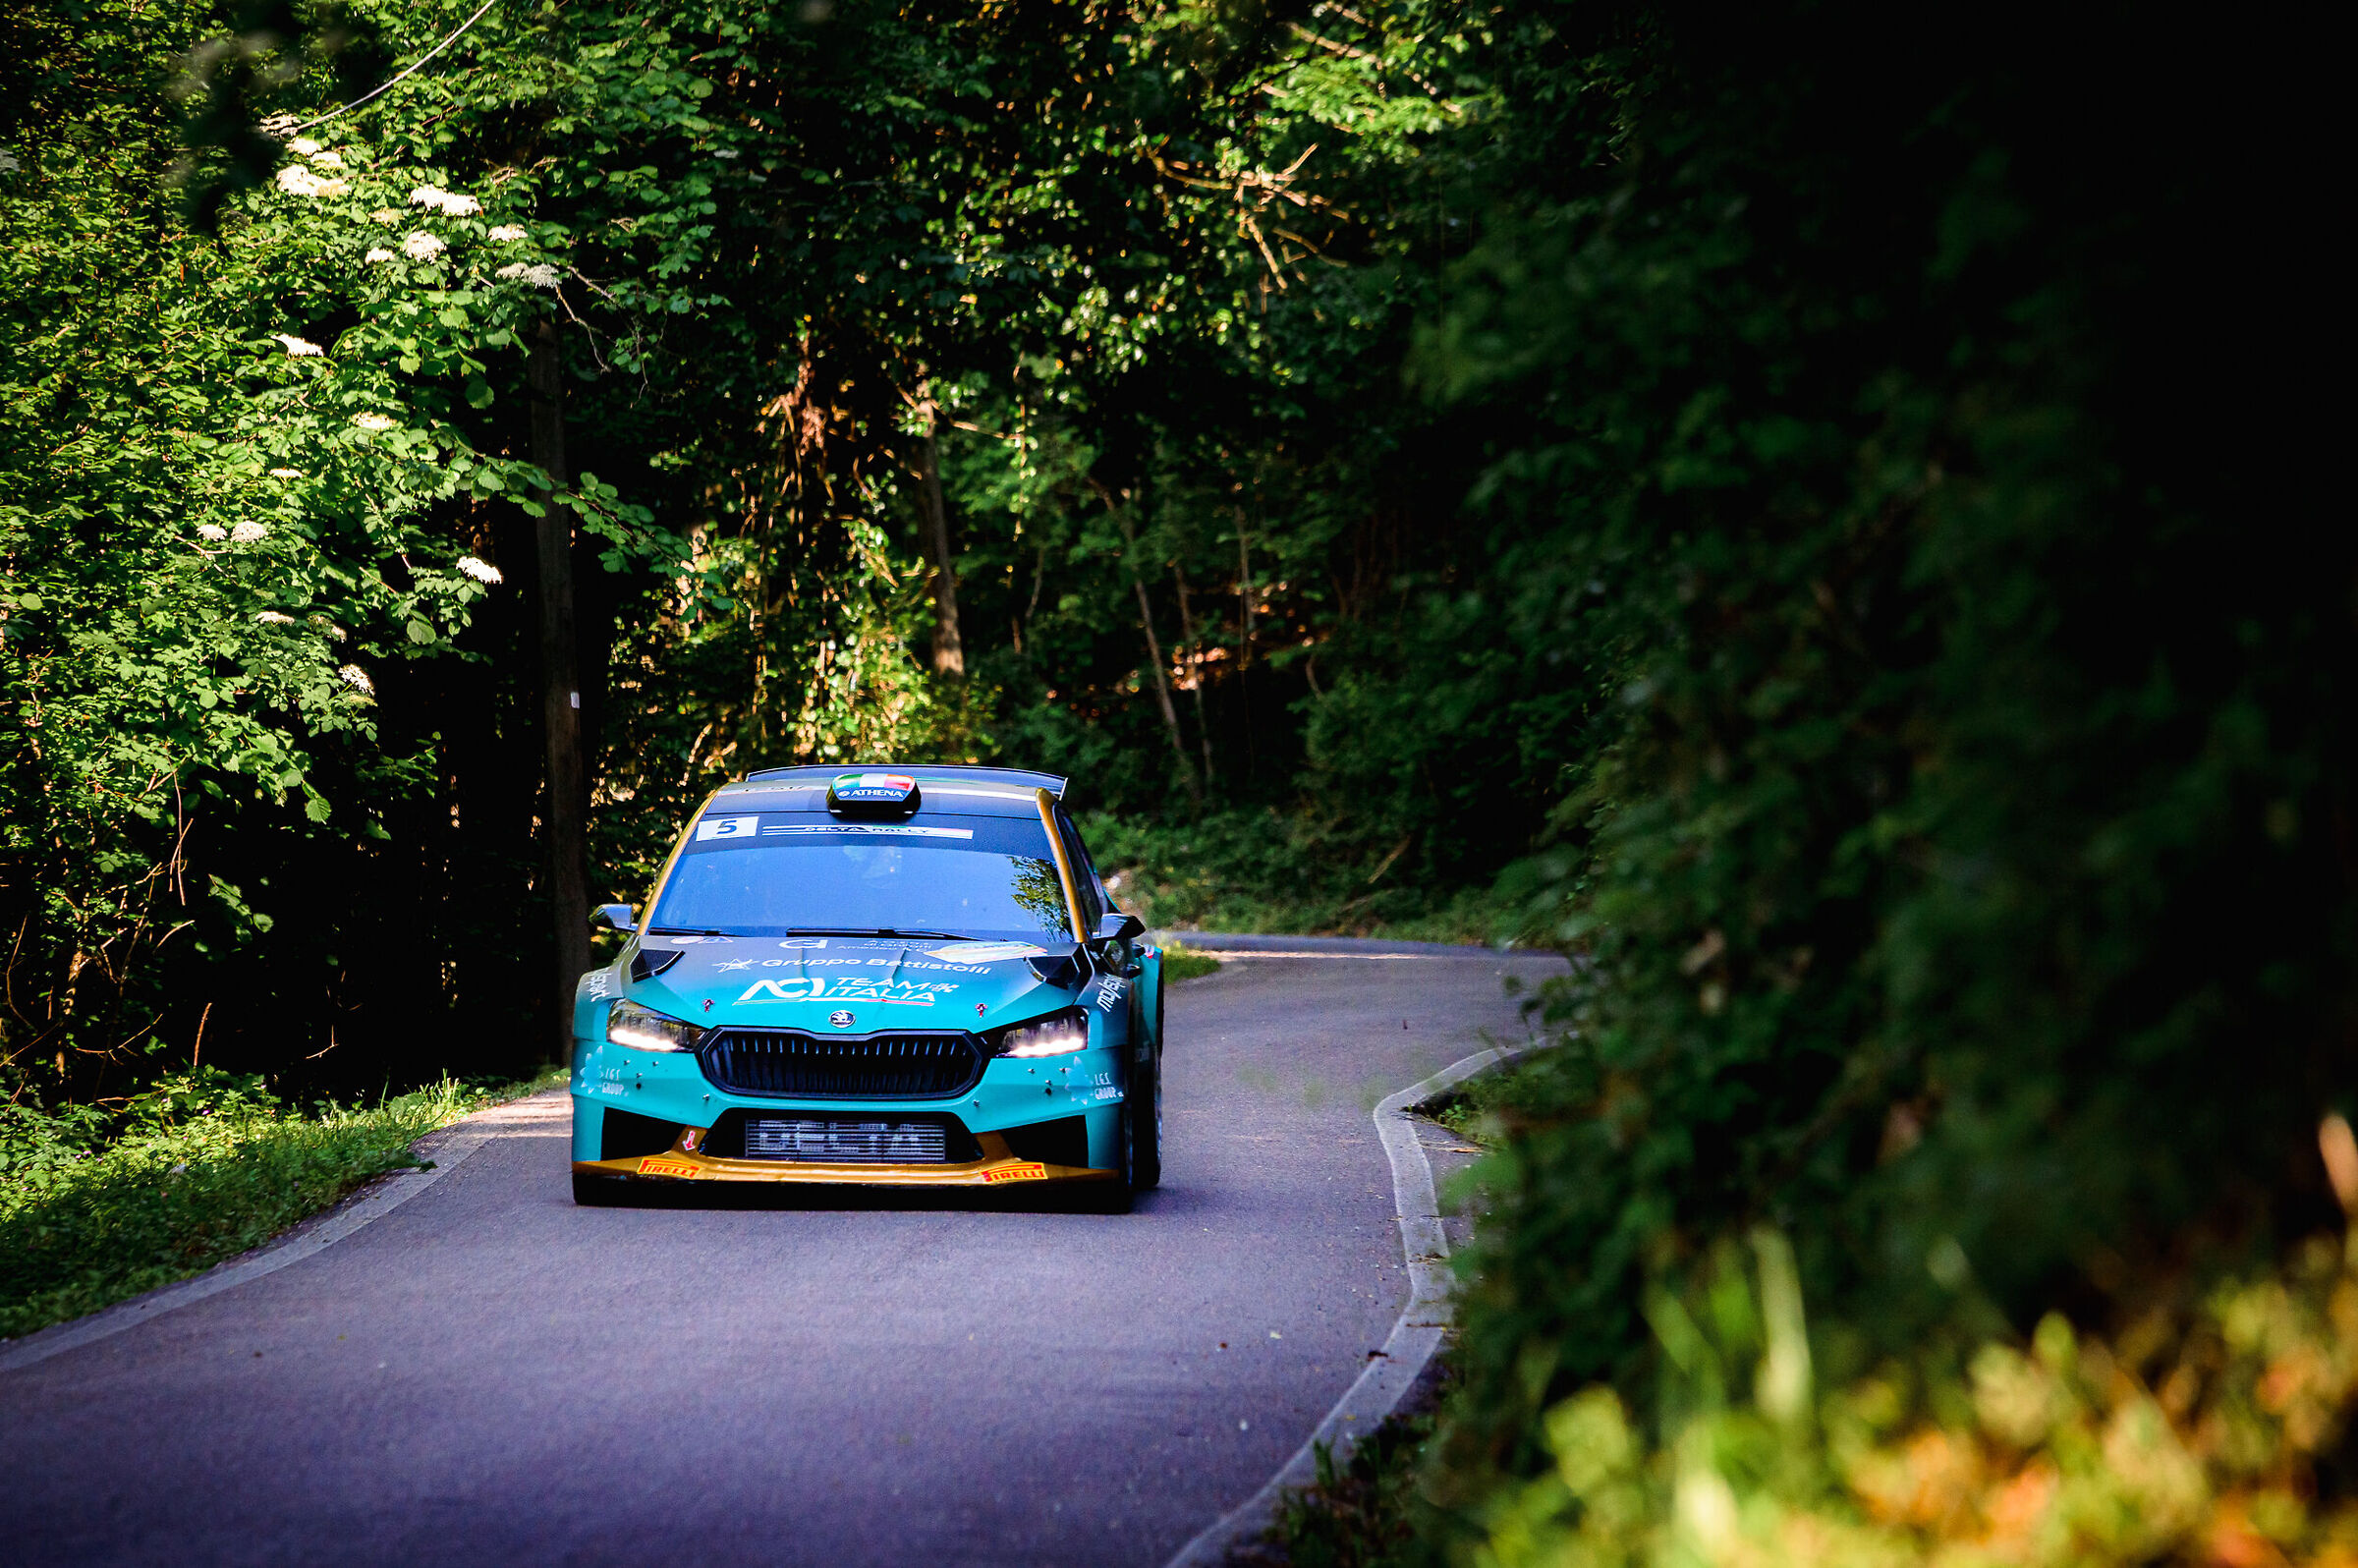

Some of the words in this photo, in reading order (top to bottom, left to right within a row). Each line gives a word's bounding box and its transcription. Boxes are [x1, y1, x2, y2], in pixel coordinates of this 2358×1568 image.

[851, 789, 904, 798] ATHENA
[716, 819, 738, 835] 5
[866, 958, 992, 975] Battistolli
[737, 977, 825, 1001] ACI
[835, 977, 931, 990] TEAM
[824, 986, 936, 1002] ITALIA
[601, 1082, 625, 1095] GROUP
[758, 1120, 923, 1154] DELTA
[638, 1159, 701, 1179] PIRELLI
[981, 1163, 1045, 1183] PIRELLI
